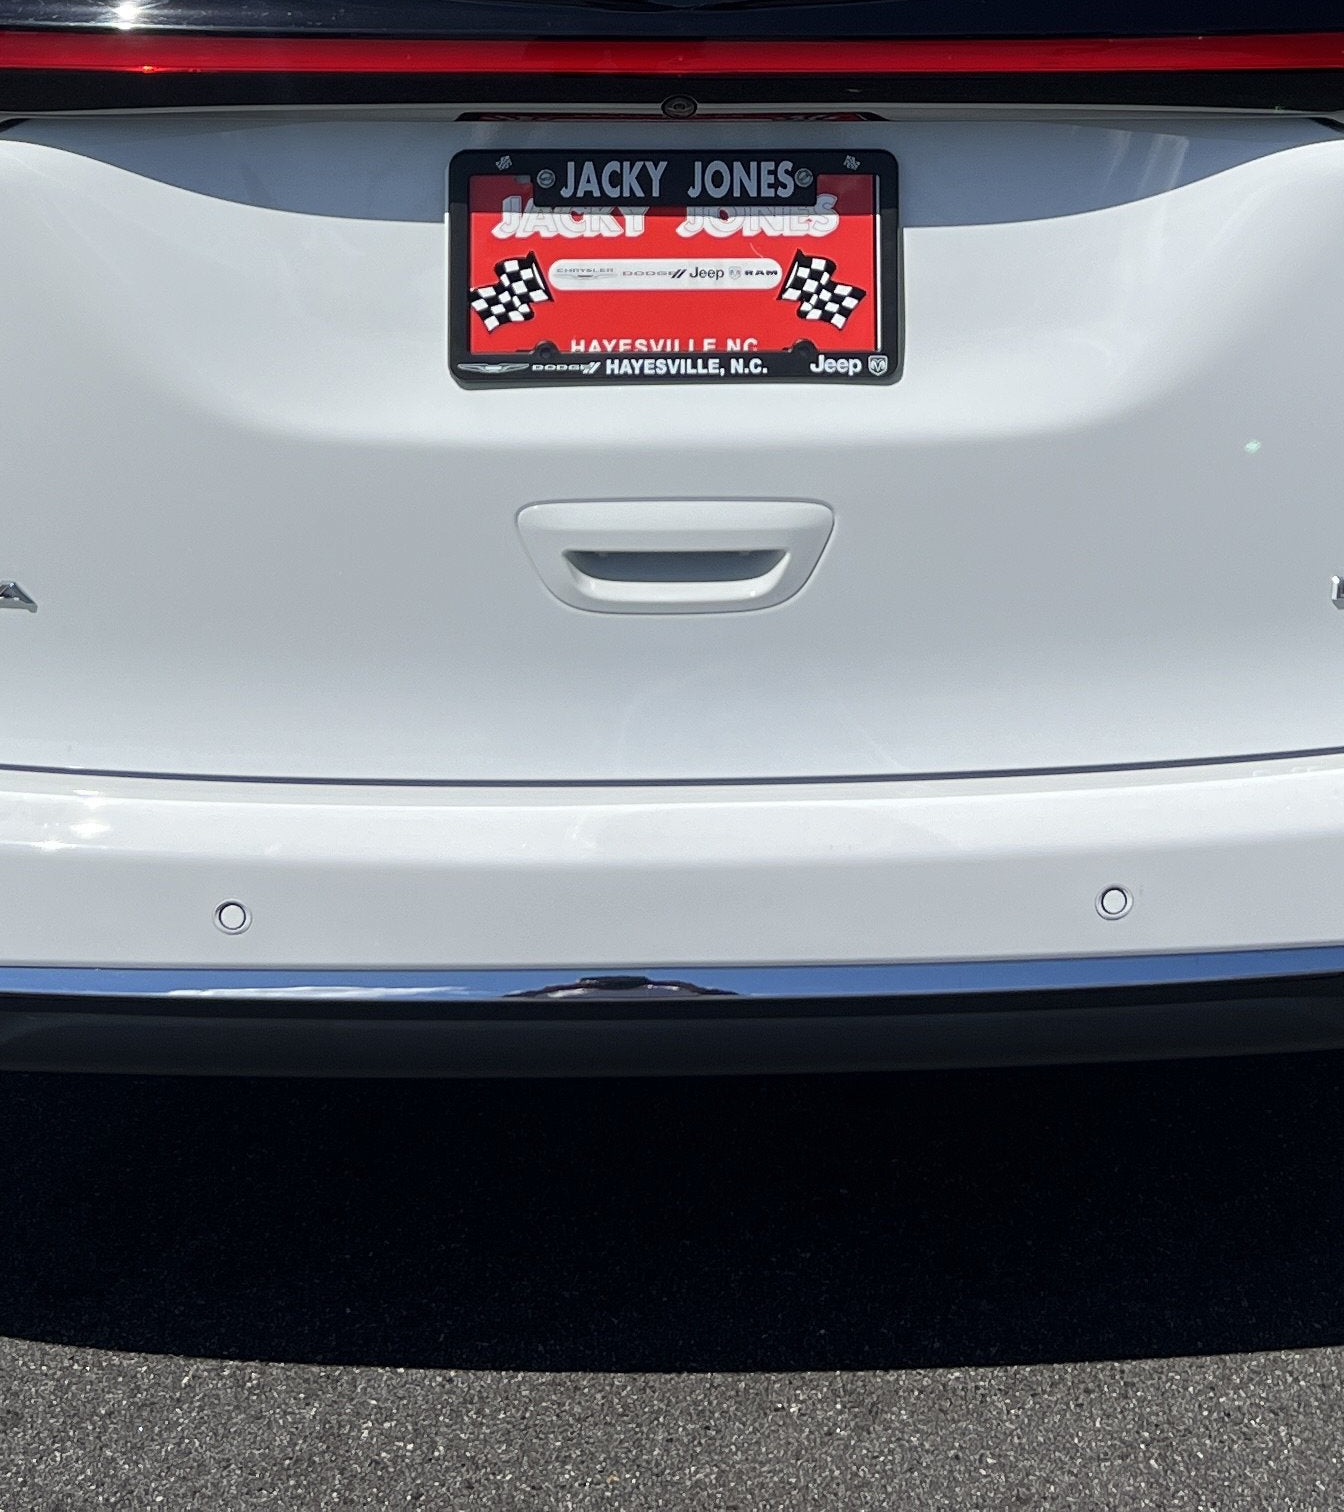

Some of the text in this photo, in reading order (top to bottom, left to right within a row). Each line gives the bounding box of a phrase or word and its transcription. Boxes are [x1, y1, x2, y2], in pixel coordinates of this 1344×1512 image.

[560, 160, 794, 199] JACKY JONES
[491, 193, 840, 239] JACKY JONES
[689, 266, 725, 280] Jeep
[606, 358, 725, 376] HAYESVILLE,
[730, 358, 768, 375] N.C.
[810, 354, 862, 376] Jeep
